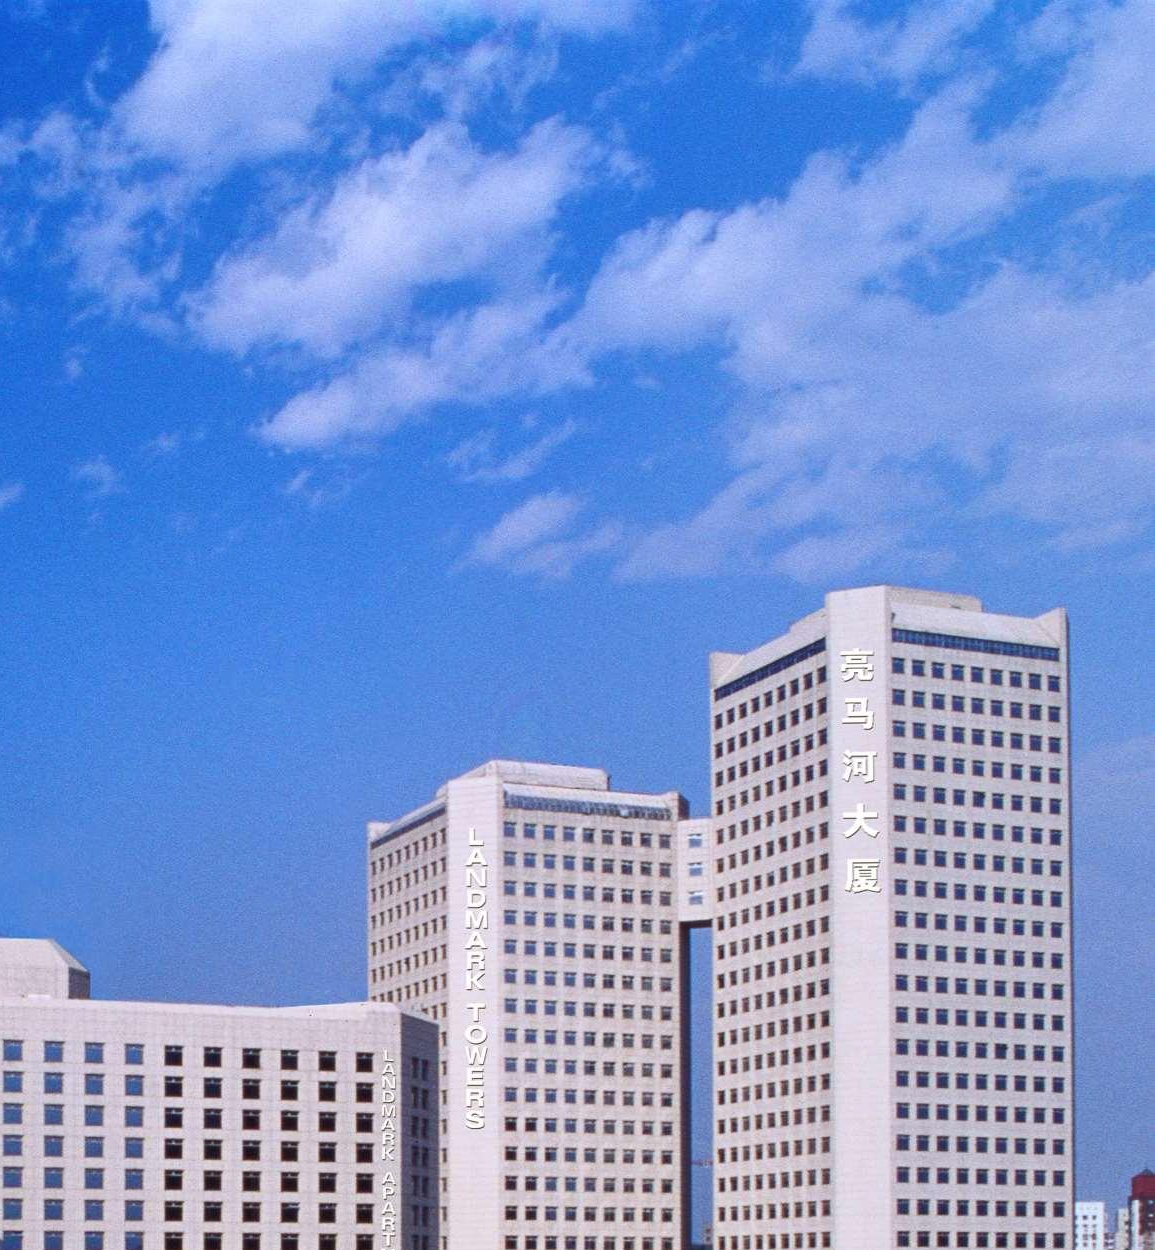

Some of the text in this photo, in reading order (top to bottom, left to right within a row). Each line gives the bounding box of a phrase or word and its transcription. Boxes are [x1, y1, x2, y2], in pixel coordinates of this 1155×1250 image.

[840, 648, 882, 894] 亮马河大厦
[465, 827, 488, 1129] LANDMARK TOWERS
[381, 1050, 396, 1161] LANDMARK
